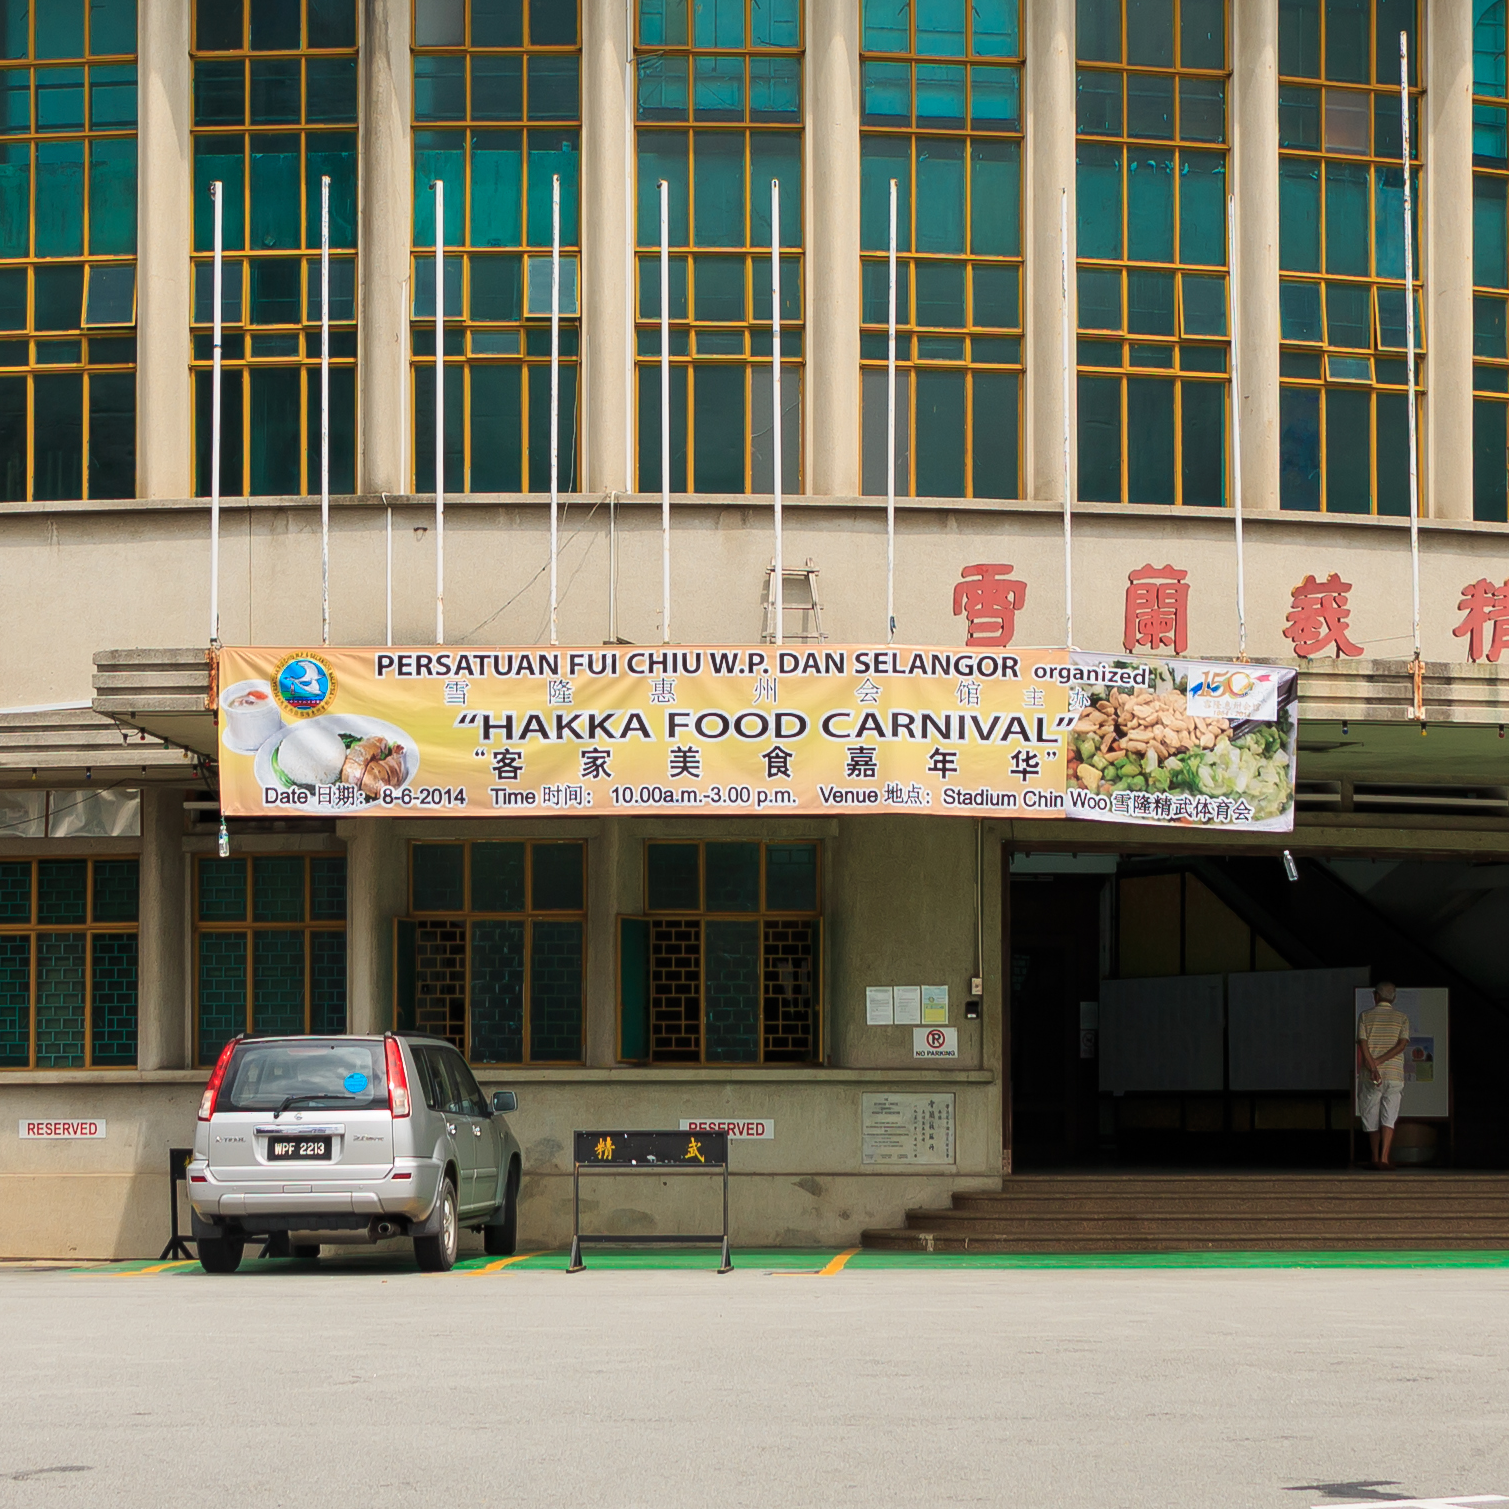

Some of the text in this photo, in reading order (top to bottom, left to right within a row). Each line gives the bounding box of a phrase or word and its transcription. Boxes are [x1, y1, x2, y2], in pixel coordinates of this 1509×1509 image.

[377, 652, 1148, 686] PERSATUAN FUI CHIU W.P. DAN SELANGOR organized
[443, 677, 1090, 707] 雪隆惠州会馆主办
[1197, 669, 1255, 699] 150
[668, 712, 805, 740] FOOD
[265, 788, 308, 804] Date
[383, 788, 465, 804] 8-6-2014
[491, 788, 535, 804] Time
[612, 787, 750, 804] 10.00a.m.-3.00
[757, 791, 797, 807] p.m.
[819, 787, 878, 803] Venue
[943, 790, 1016, 807] Stadium
[1023, 790, 1064, 808] Chin
[1070, 791, 1108, 811] Woo
[26, 1122, 98, 1137] RESERVED
[274, 1142, 325, 1156] WPF 2213
[595, 1136, 705, 1163] 精武
